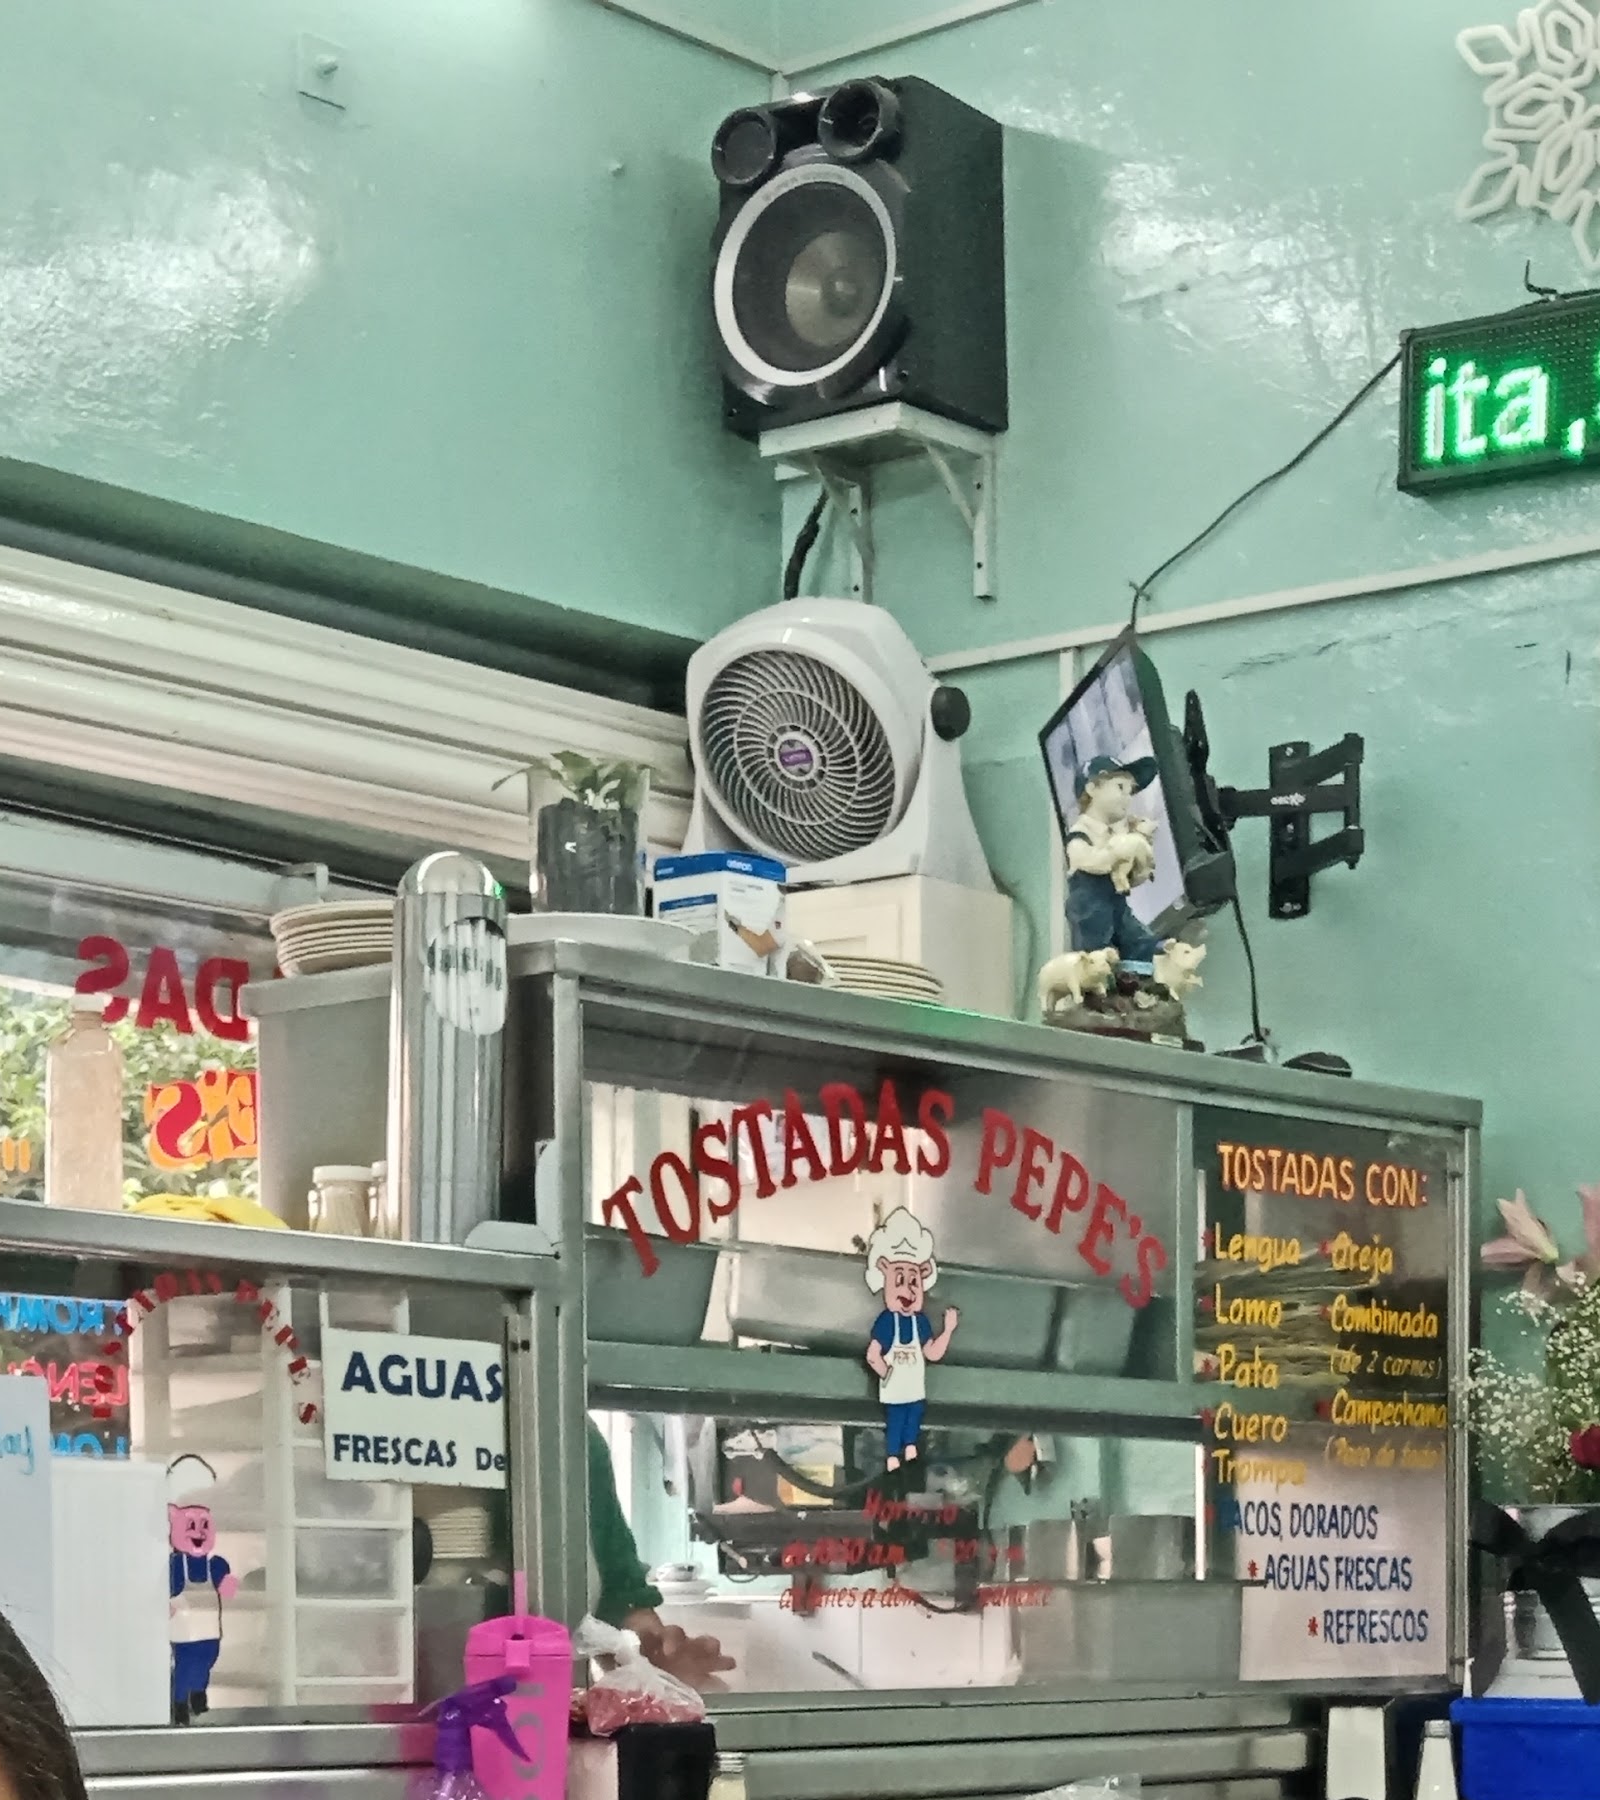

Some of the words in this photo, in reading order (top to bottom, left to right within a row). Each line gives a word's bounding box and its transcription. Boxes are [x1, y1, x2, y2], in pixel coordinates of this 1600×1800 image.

[603, 1079, 955, 1278] TOSTADAS
[973, 1108, 1168, 1310] PEPE'S
[1218, 1143, 1355, 1202] TOSTADAS
[1366, 1162, 1428, 1209] CON:
[1215, 1222, 1301, 1272] Lengua
[1215, 1283, 1283, 1328] Lomo
[1331, 1294, 1438, 1338] Combinada
[341, 1350, 503, 1403] AGUAS
[1217, 1343, 1280, 1389] Pata
[1213, 1402, 1288, 1442] Cuero
[333, 1433, 457, 1468] FRESCAS
[1290, 1503, 1379, 1540] DORADOS
[1264, 1554, 1329, 1592] AGUAS
[1335, 1556, 1413, 1592] FRESCAS
[1323, 1608, 1429, 1645] REFRESCOS
